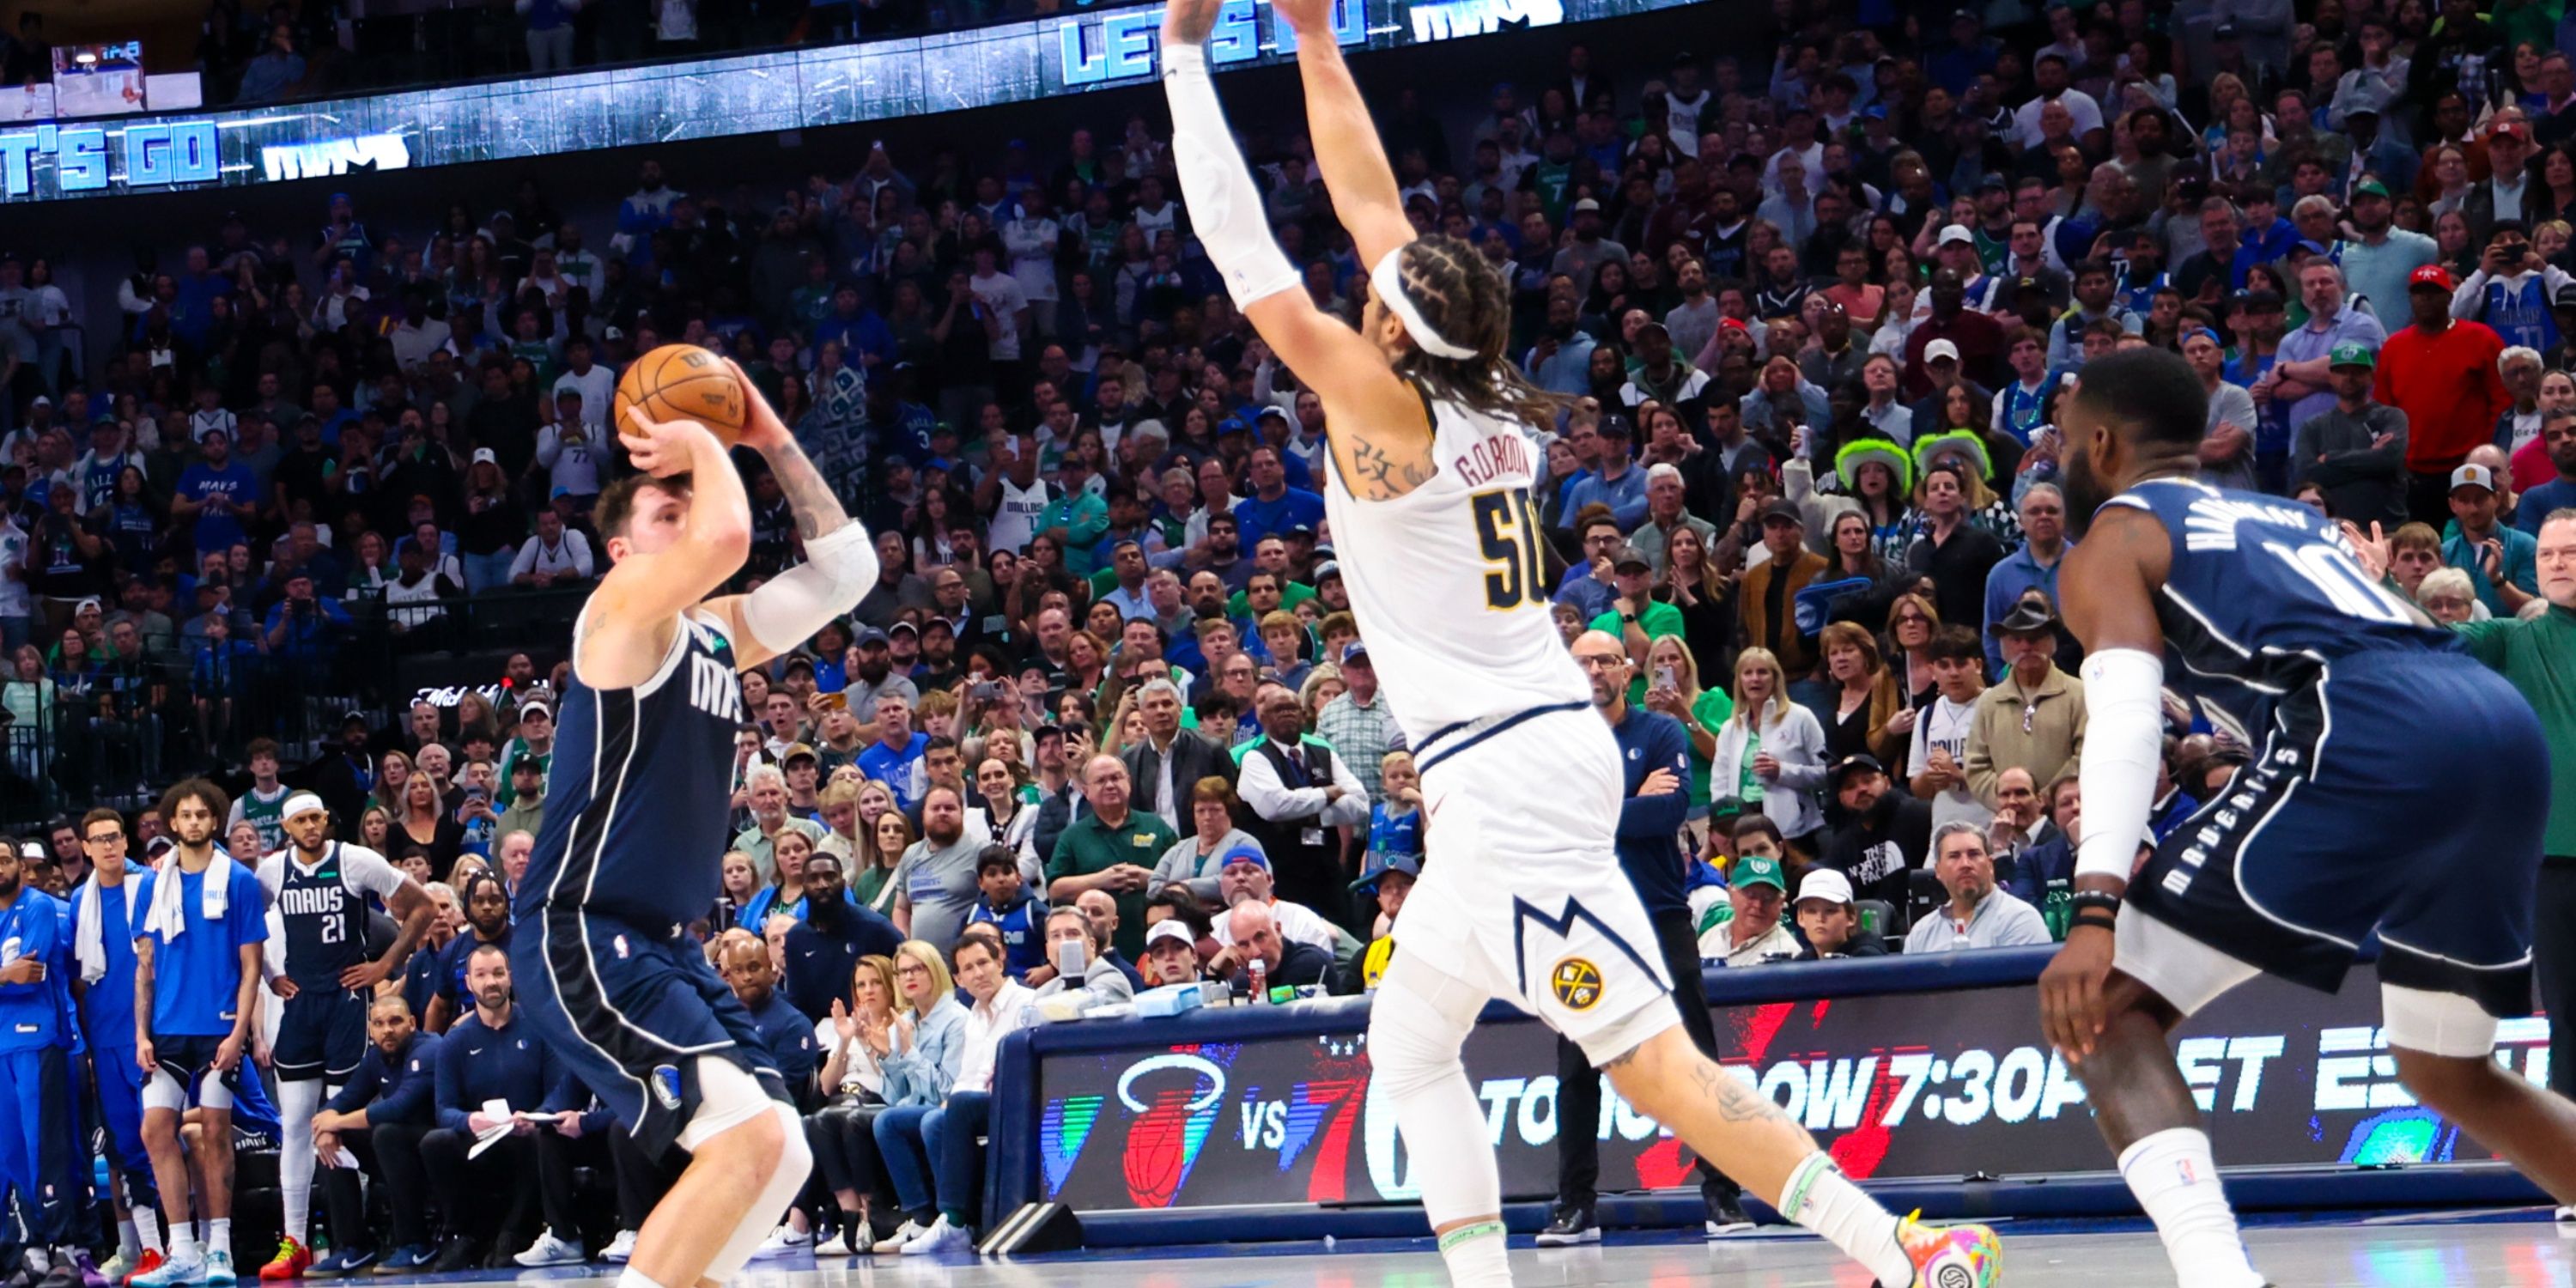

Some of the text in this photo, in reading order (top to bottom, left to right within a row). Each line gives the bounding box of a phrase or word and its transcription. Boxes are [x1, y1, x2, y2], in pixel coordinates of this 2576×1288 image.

[1060, 0, 1258, 84] LES
[124, 121, 221, 186] GO
[918, 430, 931, 449] 3
[198, 480, 238, 491] MAVS
[1470, 488, 1545, 612] 50
[2261, 541, 2413, 625] 10
[283, 886, 343, 914] MAVS
[322, 914, 346, 944] 21
[2175, 1036, 2285, 1112] ET
[1241, 1100, 1287, 1150] VS
